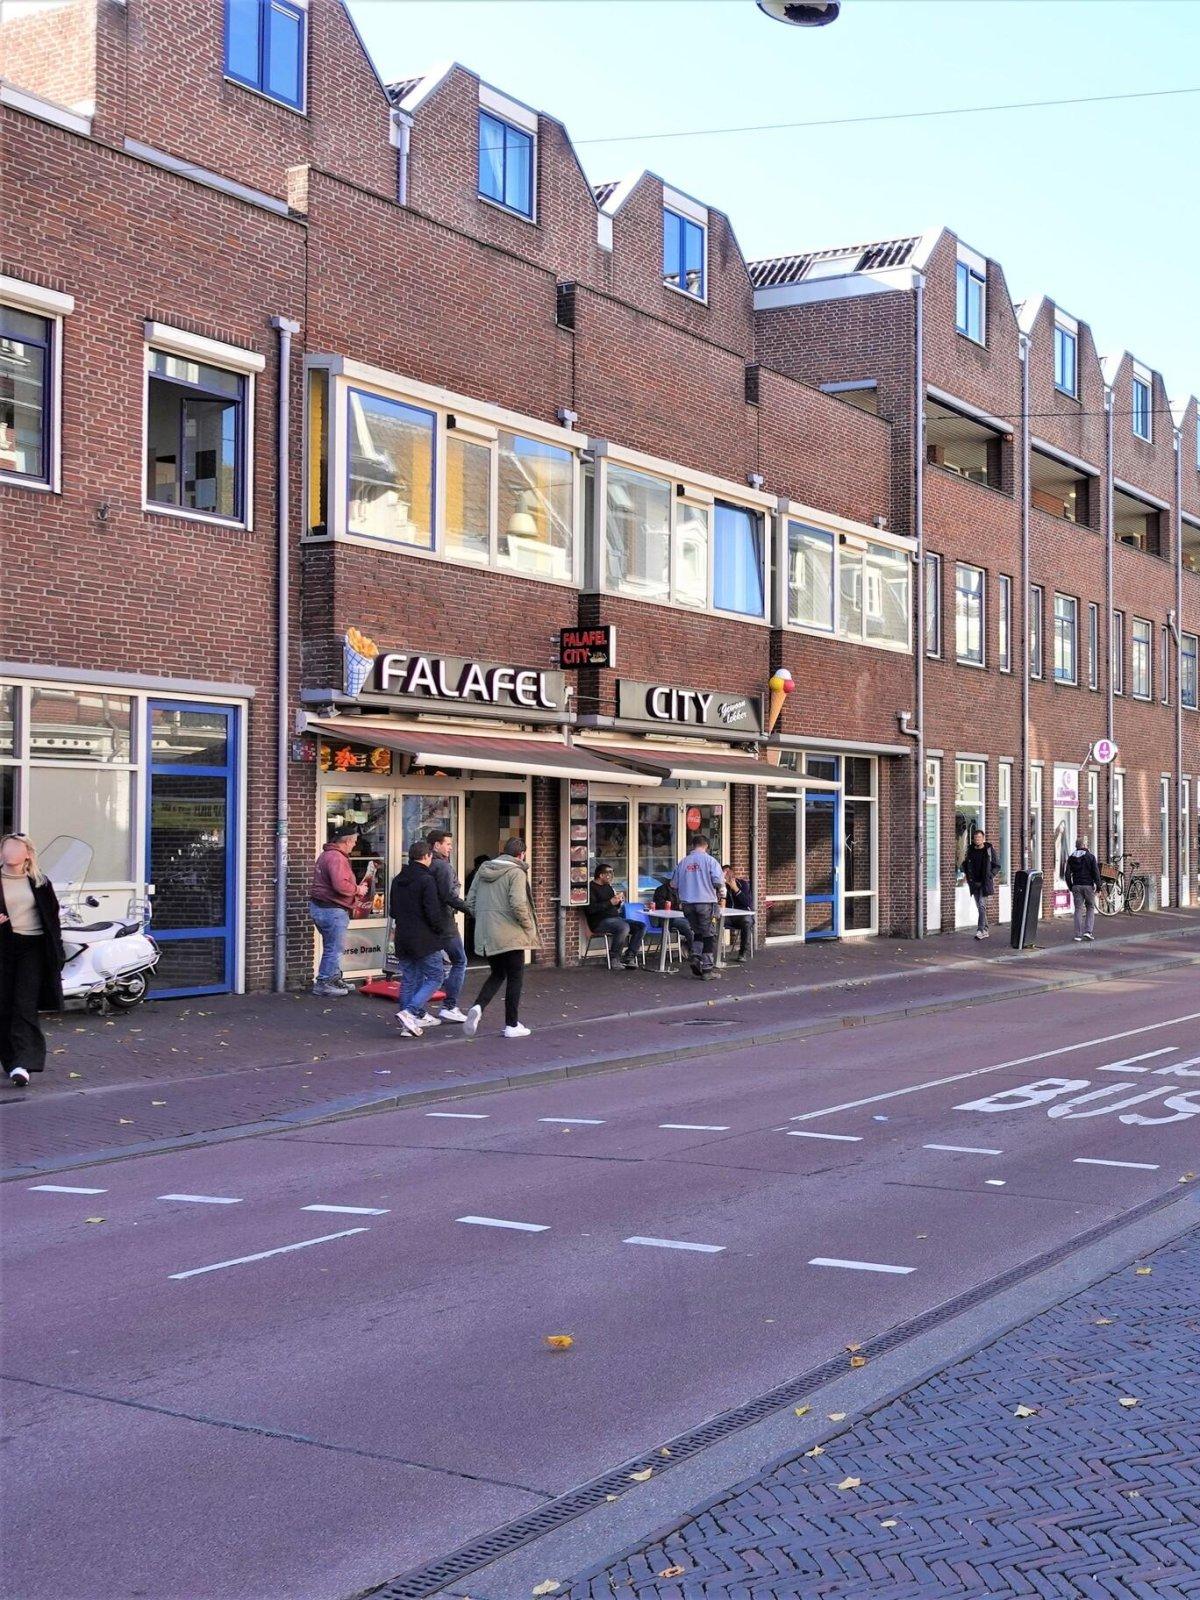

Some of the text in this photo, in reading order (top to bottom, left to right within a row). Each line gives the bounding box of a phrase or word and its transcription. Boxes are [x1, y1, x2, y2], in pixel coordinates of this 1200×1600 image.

[563, 631, 607, 647] FALAFEL
[563, 648, 589, 664] CITY
[381, 654, 556, 709] FALAFEL
[652, 687, 713, 723] CITY
[360, 944, 382, 953] Drank
